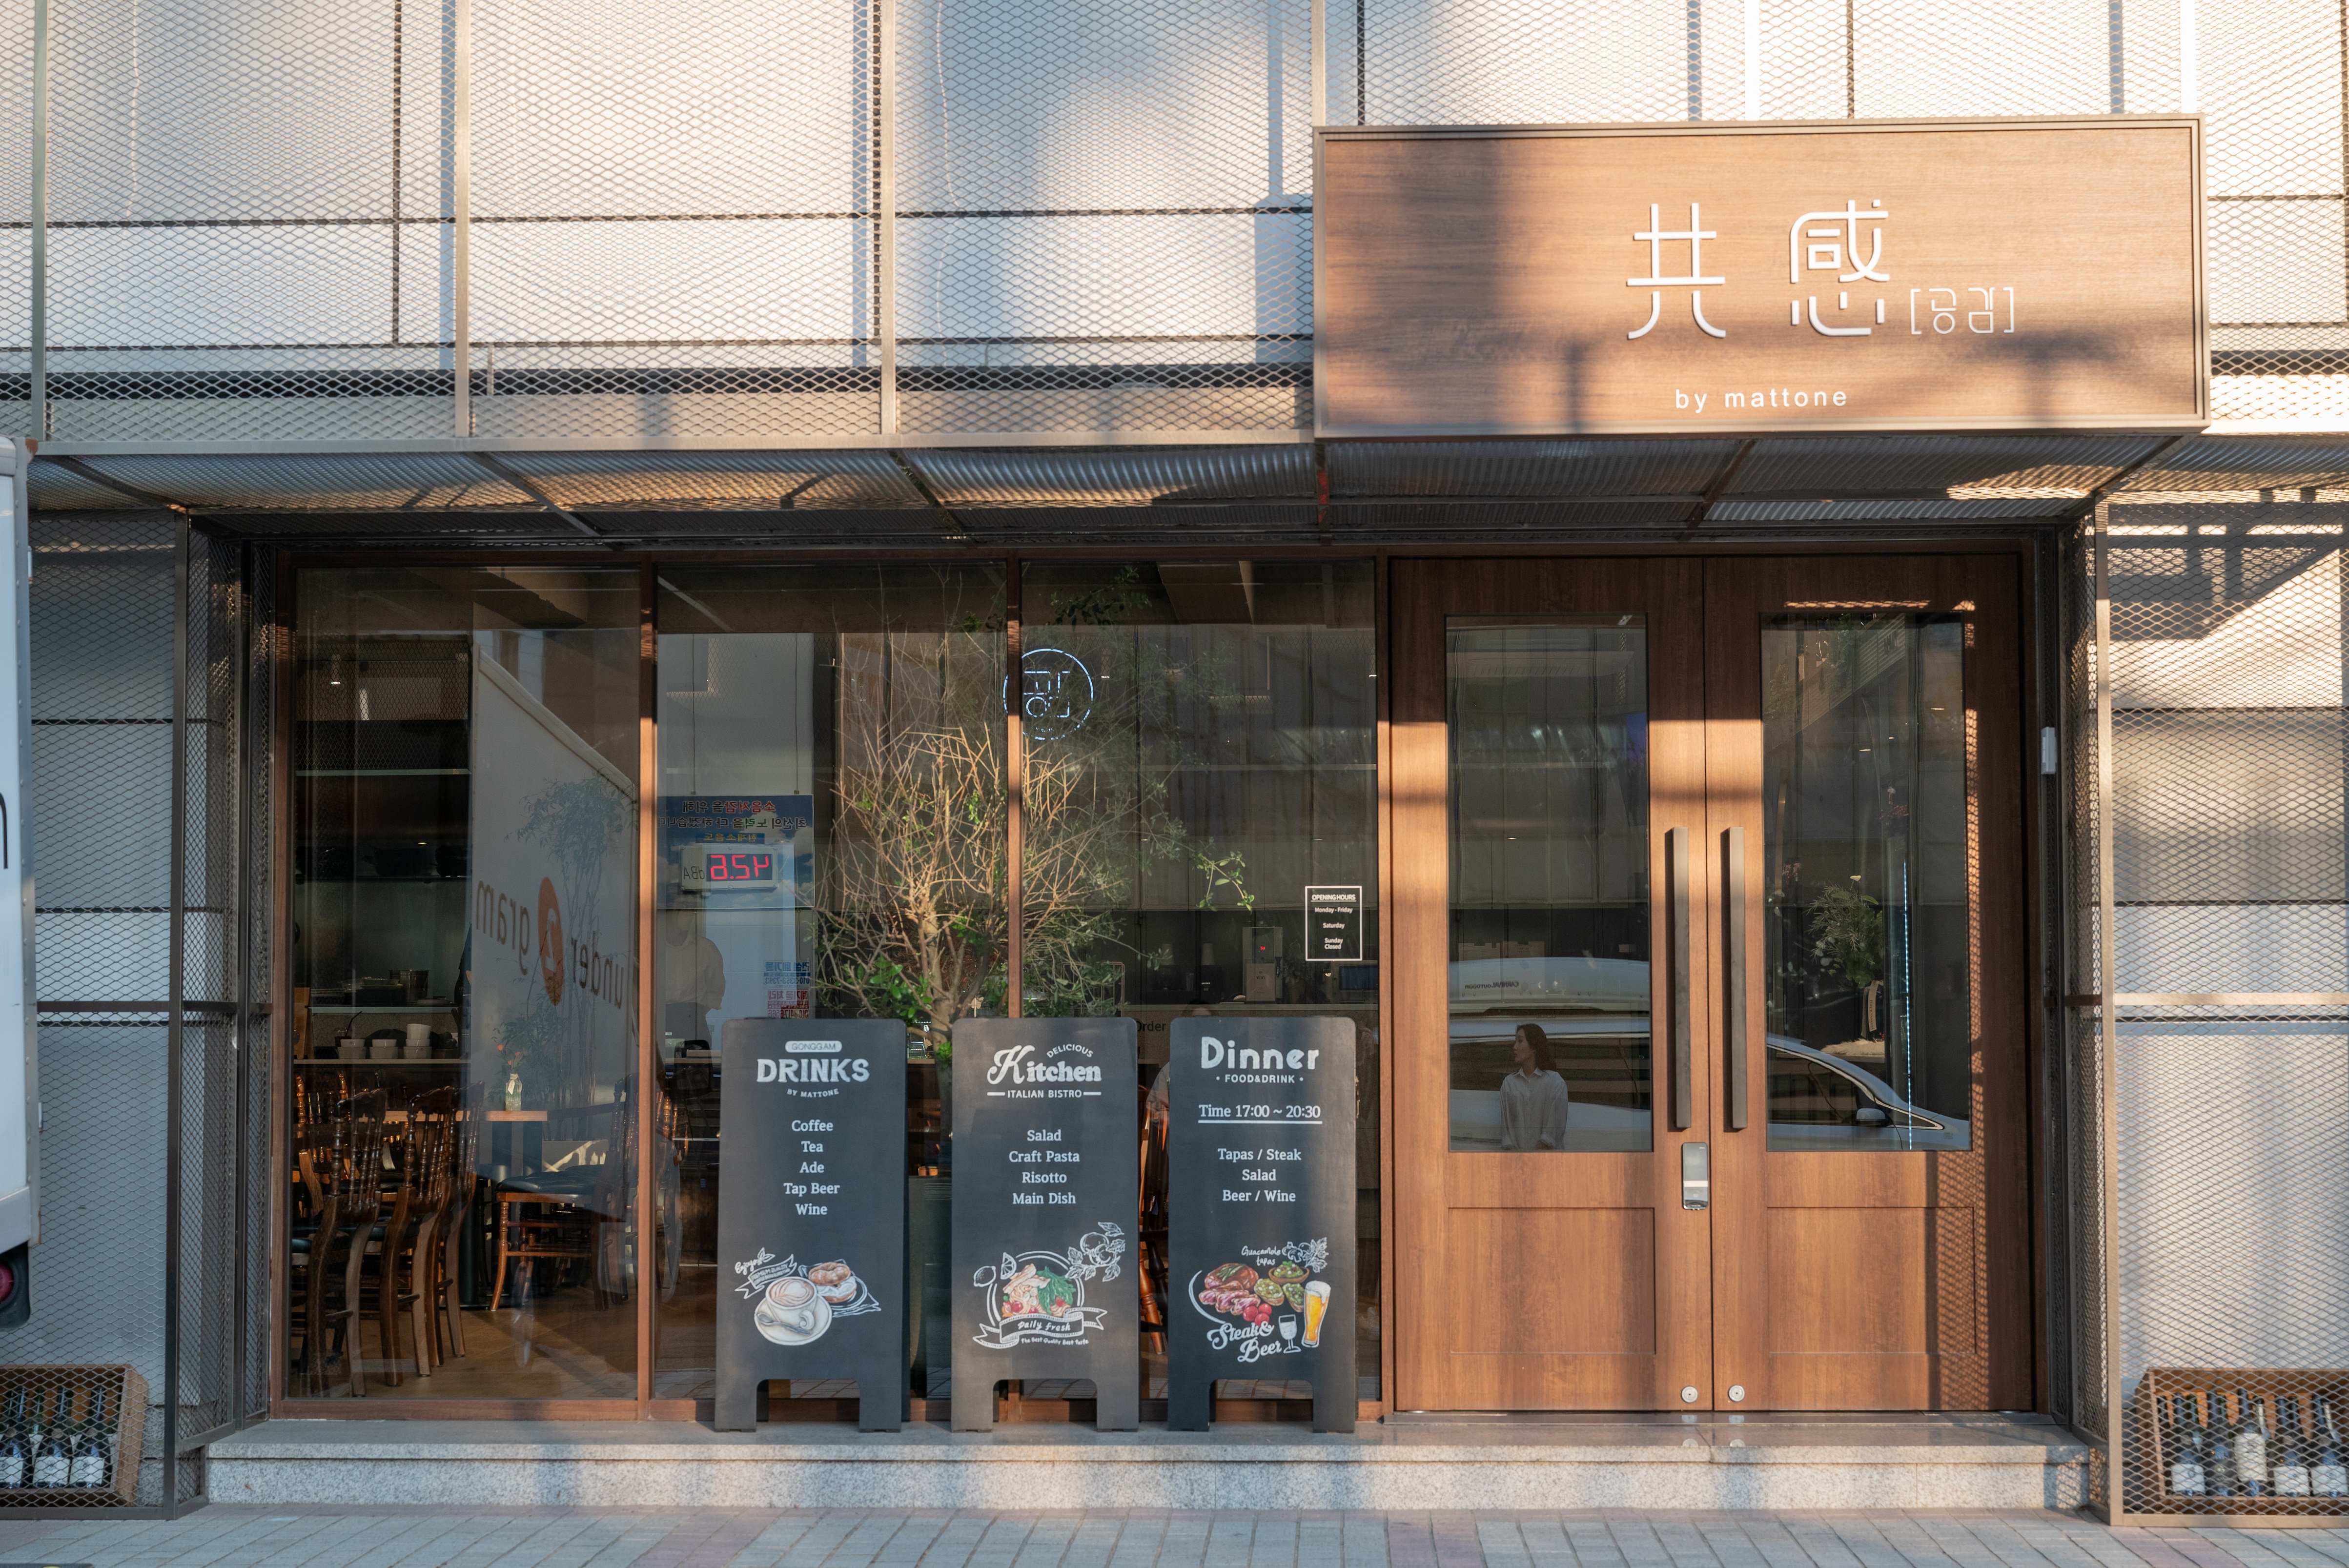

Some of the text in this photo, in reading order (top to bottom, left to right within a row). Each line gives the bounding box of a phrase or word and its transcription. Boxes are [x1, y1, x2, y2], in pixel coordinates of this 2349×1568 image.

[1627, 199, 1890, 339] 共感
[1675, 388, 1846, 413] by mattone
[1046, 1043, 1094, 1059] DELICIOUS
[1201, 1036, 1320, 1070] Dinner
[756, 1059, 870, 1082] DRINKS
[986, 1044, 1102, 1084] Kitchen
[1225, 1074, 1295, 1084] FOOD&DRINK
[800, 1088, 839, 1098] MATTONE
[1007, 1089, 1082, 1099] ITALIAN BISTRO
[1198, 1104, 1231, 1118] Time
[1235, 1104, 1270, 1118] 17:00
[1286, 1105, 1321, 1119] 20:30
[791, 1119, 834, 1132] Coffee
[1027, 1129, 1062, 1141] Salad
[801, 1140, 824, 1153] Tea
[1008, 1150, 1080, 1162] Craft Pasta
[1217, 1148, 1254, 1163] Tapas
[1266, 1148, 1302, 1161] Steak
[799, 1161, 825, 1174] Ade
[1021, 1171, 1067, 1183] Risotto
[1242, 1168, 1277, 1181] Salad
[783, 1182, 841, 1197] Tap Beer
[1222, 1189, 1252, 1202] Beer
[1264, 1189, 1296, 1202] Wine
[1012, 1192, 1077, 1204] Main Dish
[795, 1203, 828, 1216] Wine
[1256, 1256, 1276, 1266] tapas
[1237, 1337, 1283, 1363] Beer
